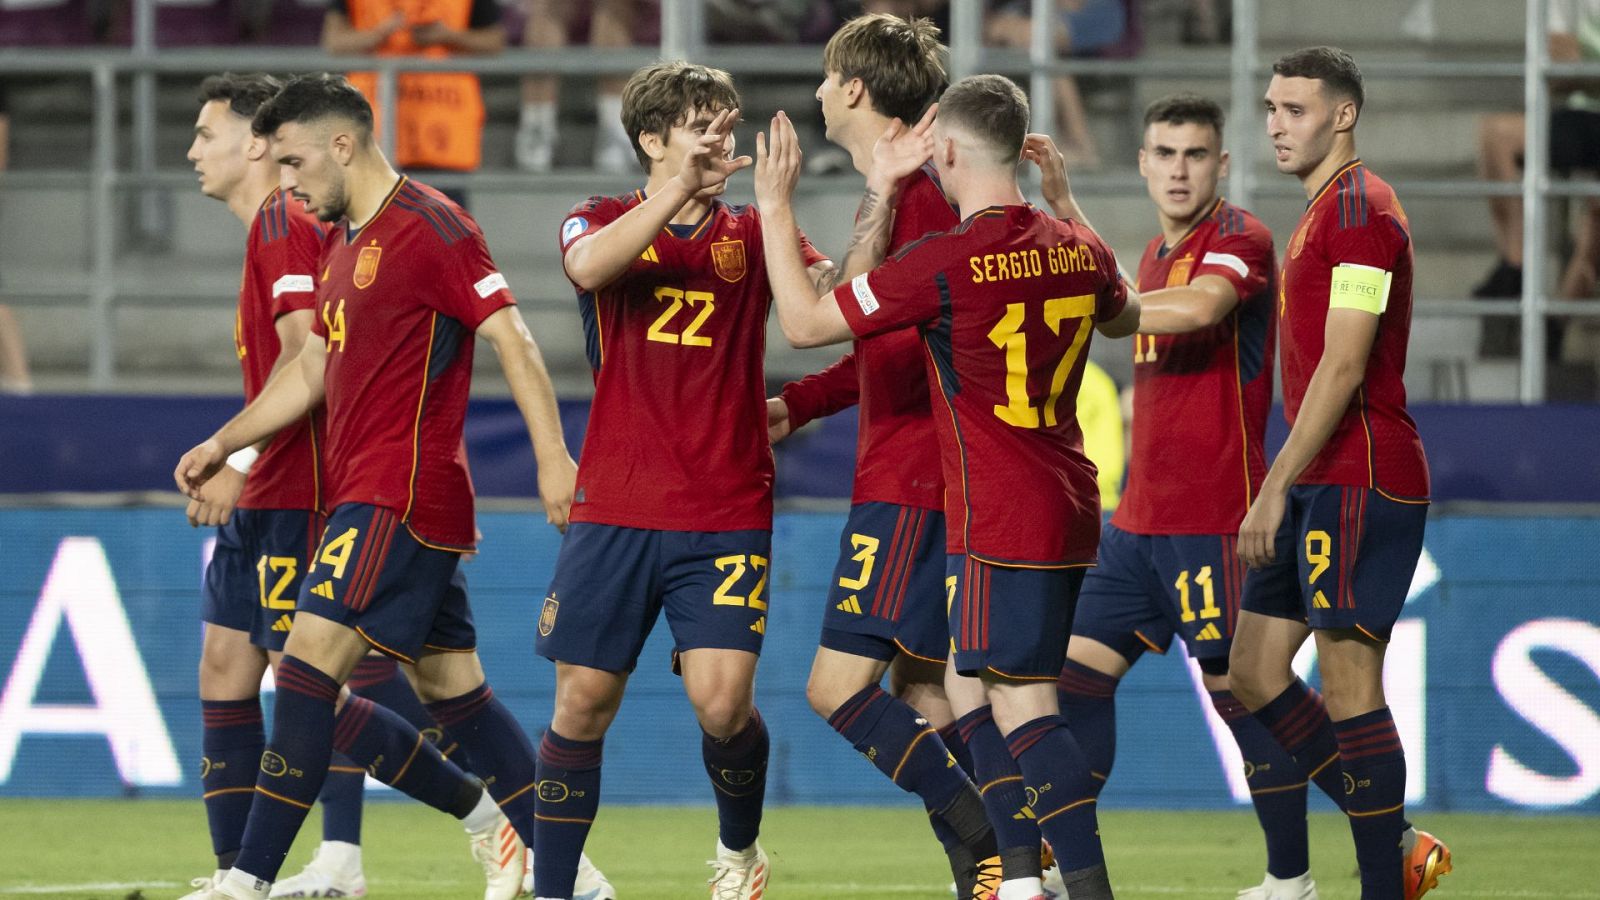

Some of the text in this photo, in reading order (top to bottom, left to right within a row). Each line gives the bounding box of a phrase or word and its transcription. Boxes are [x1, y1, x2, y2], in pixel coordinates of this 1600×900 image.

[970, 249, 1042, 283] SERGIO
[1340, 282, 1377, 296] REPECT
[647, 286, 715, 347] 22
[987, 294, 1094, 429] 17
[255, 555, 296, 610] 12
[711, 554, 767, 611] 22
[838, 533, 879, 591] 3
[1303, 529, 1329, 585] 9
[1174, 564, 1219, 623] 11
